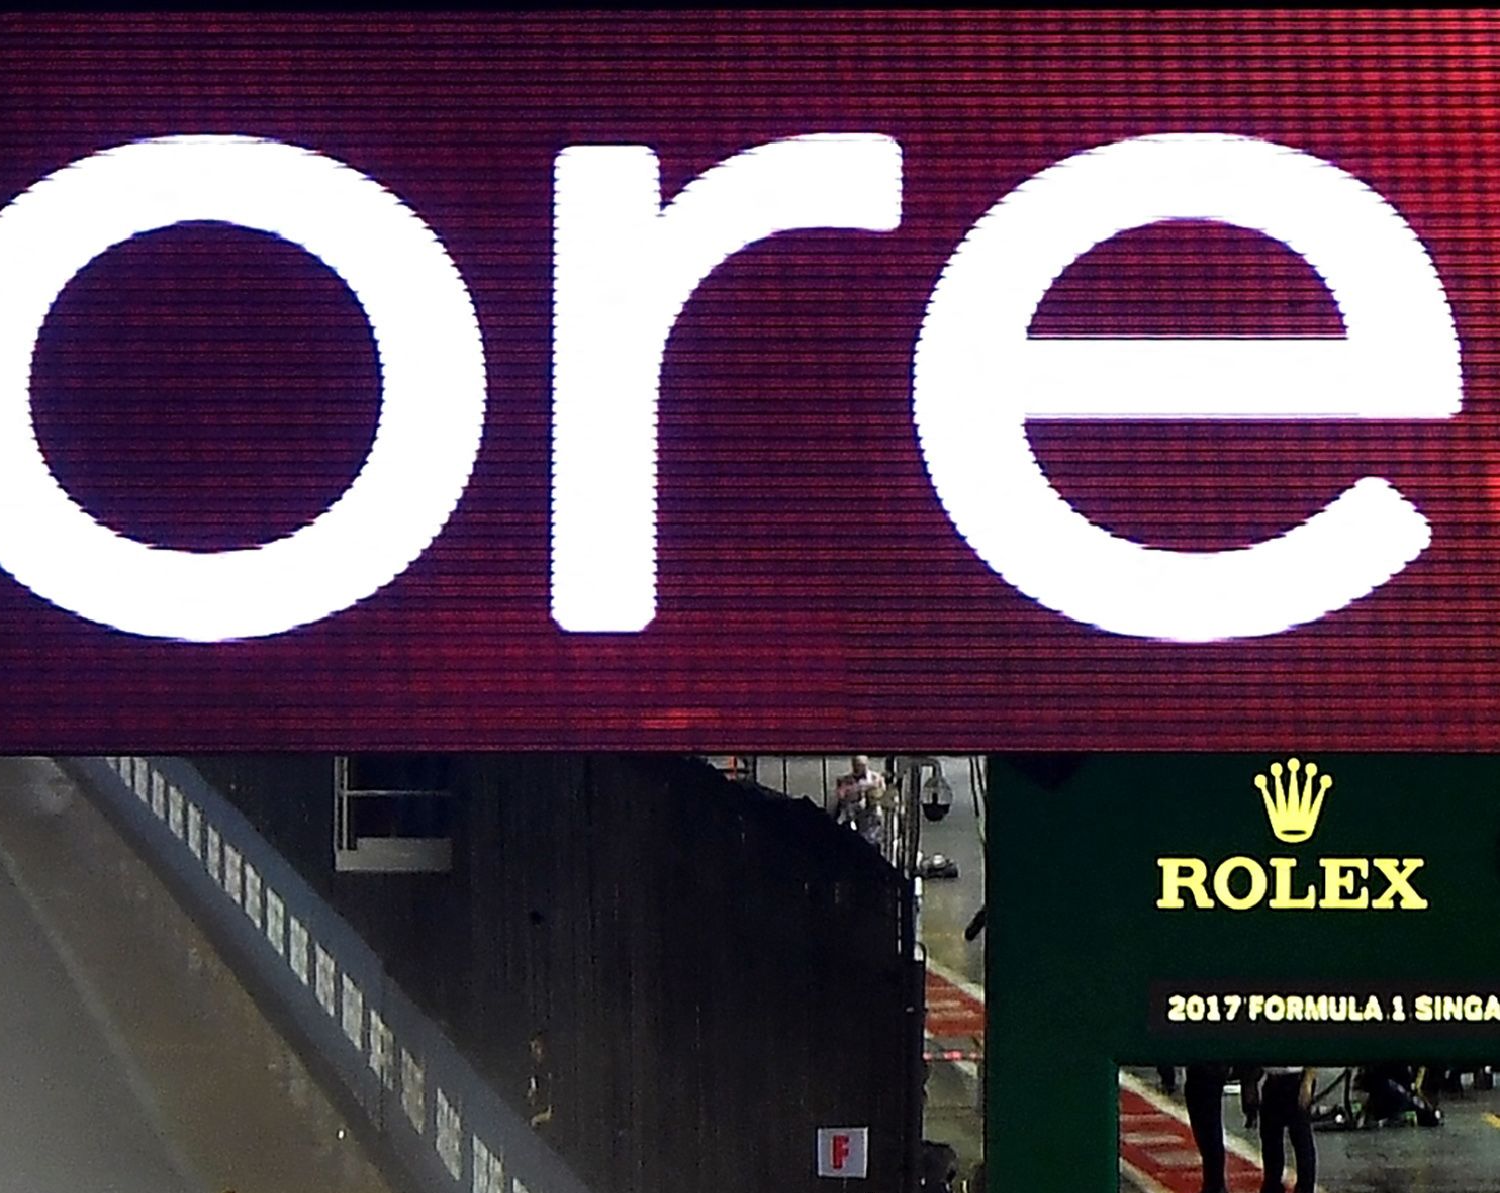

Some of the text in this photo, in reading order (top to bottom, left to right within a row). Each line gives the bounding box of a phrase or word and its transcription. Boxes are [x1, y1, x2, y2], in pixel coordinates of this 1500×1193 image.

[1156, 856, 1428, 910] ROLEX
[1167, 994, 1500, 1021] 2017 FORMULA 1 SINGA
[832, 1134, 850, 1170] F
